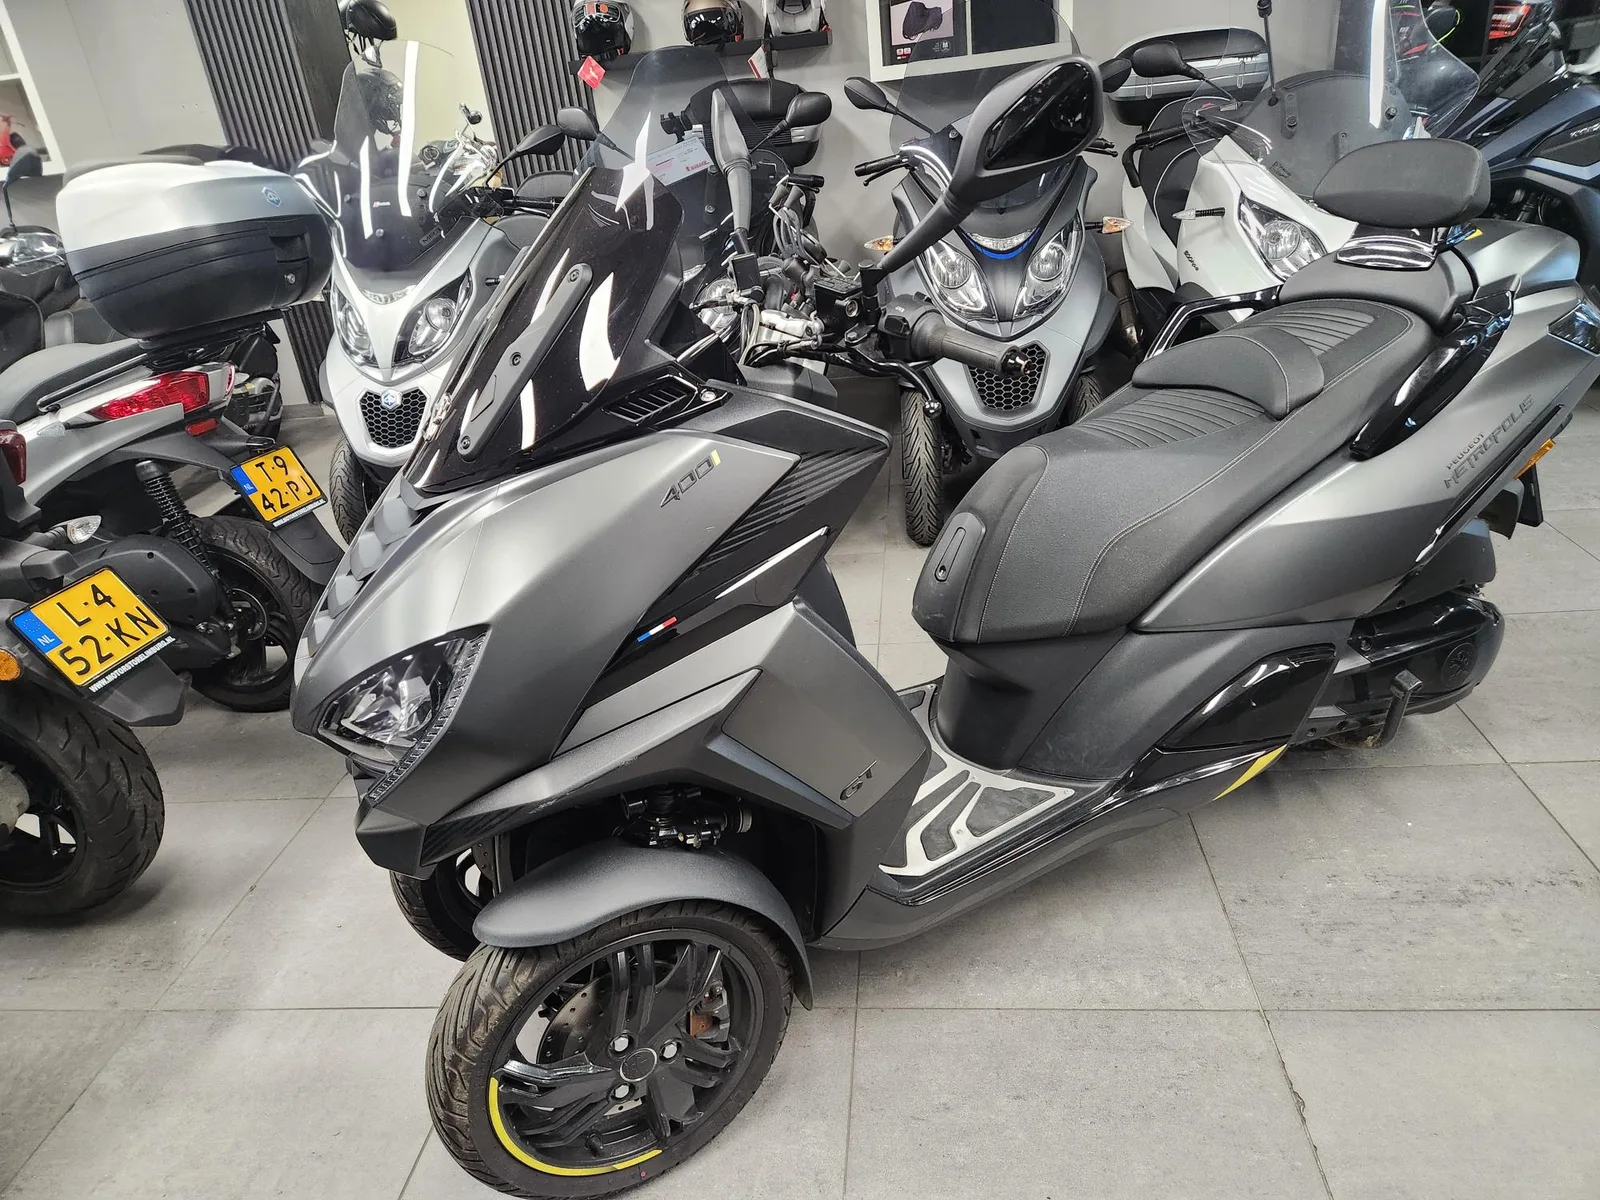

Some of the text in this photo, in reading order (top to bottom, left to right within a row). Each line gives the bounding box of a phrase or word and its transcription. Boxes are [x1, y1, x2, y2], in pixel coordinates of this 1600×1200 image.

[1443, 393, 1535, 489] METROPOLIS
[1446, 432, 1484, 470] PEUGEOT
[37, 634, 56, 647] NL
[840, 759, 877, 800] GT
